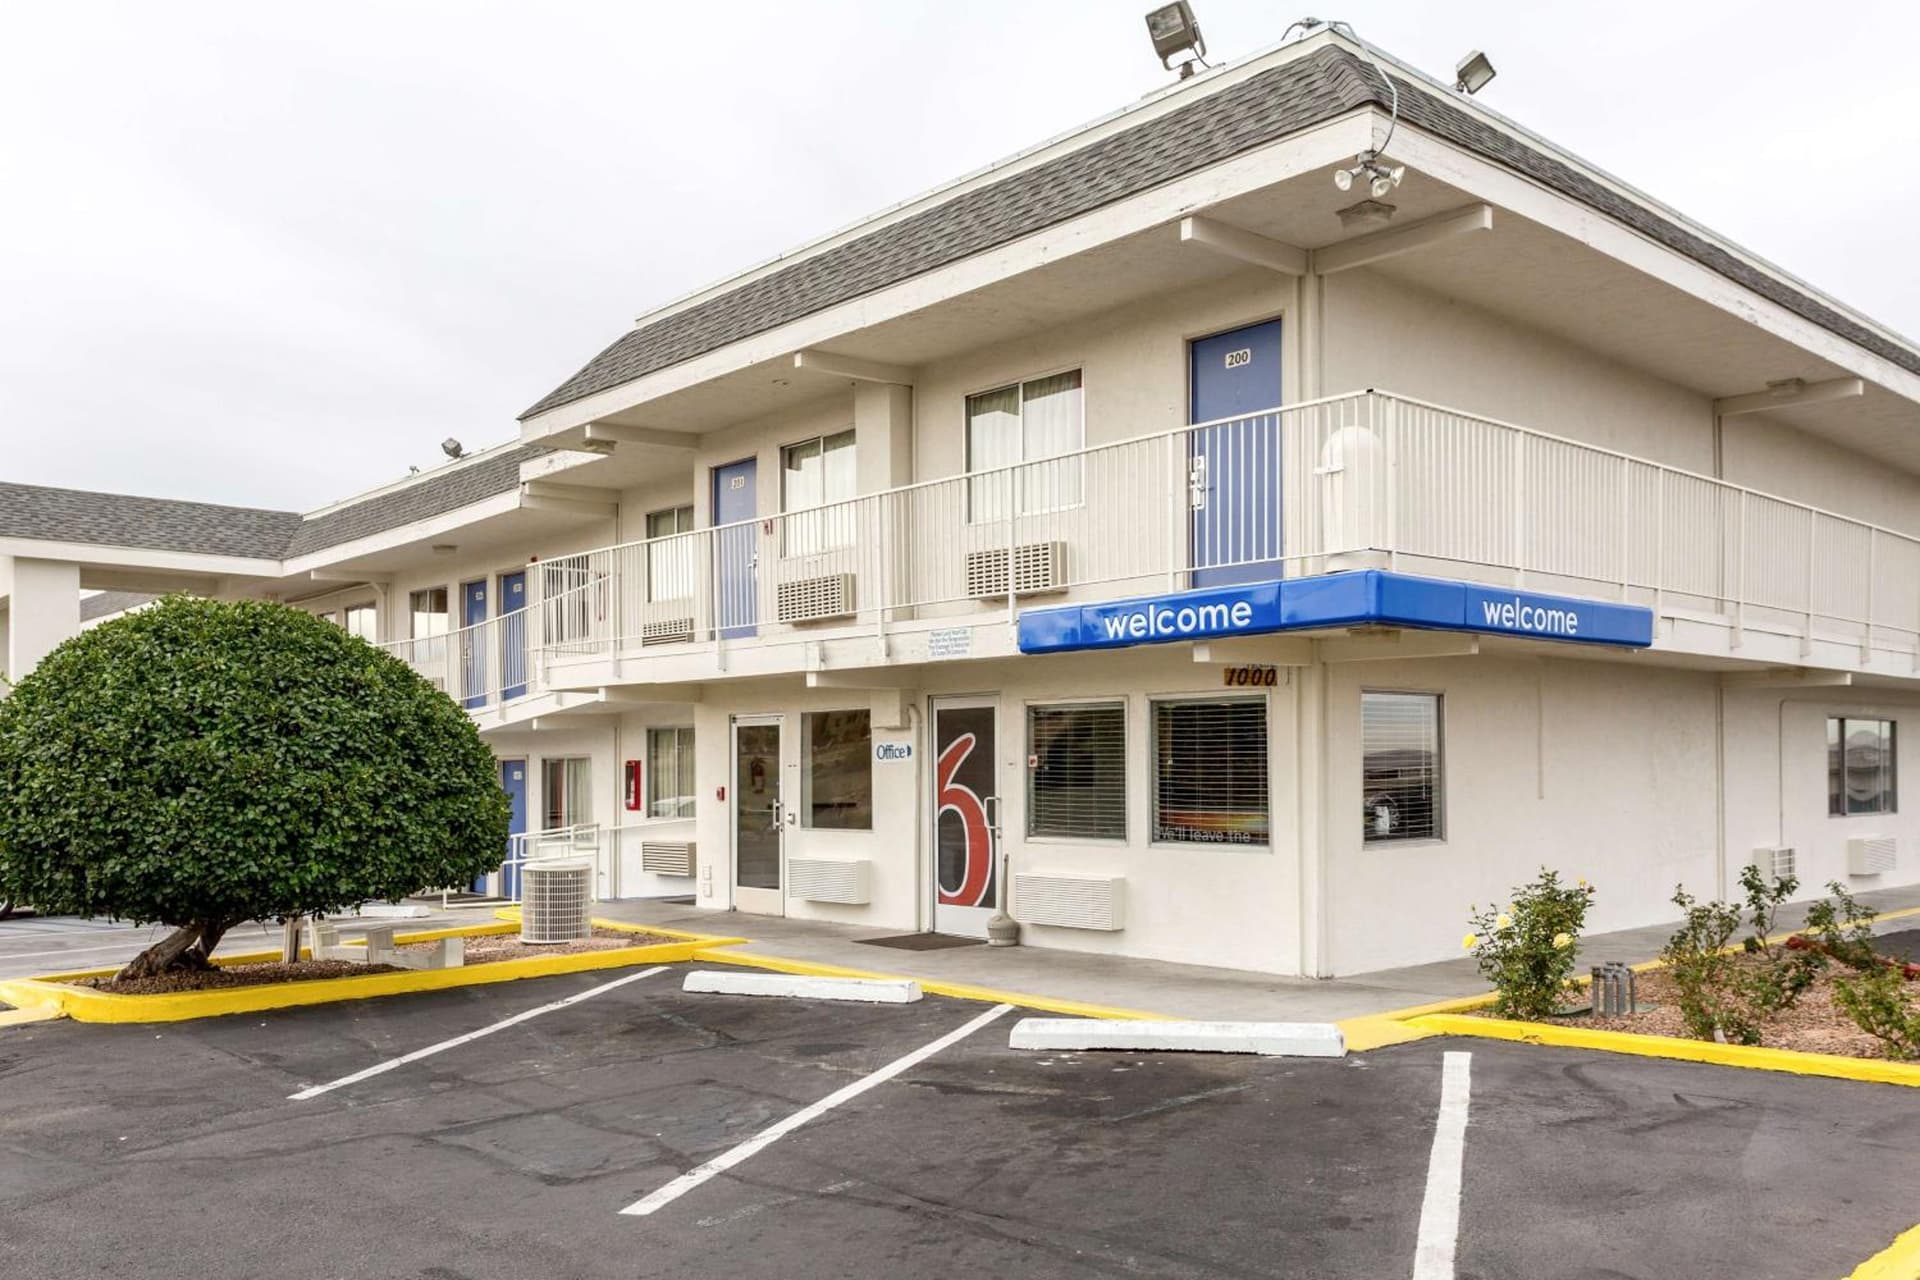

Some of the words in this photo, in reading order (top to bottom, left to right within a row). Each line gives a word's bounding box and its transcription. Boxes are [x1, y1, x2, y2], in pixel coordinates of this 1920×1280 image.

[1228, 350, 1249, 366] 200
[1104, 601, 1252, 640] welcome
[1482, 597, 1578, 635] welcome
[1225, 667, 1276, 686] 1000
[876, 744, 905, 760] Office
[938, 732, 993, 907] 6
[1189, 826, 1224, 842] leave
